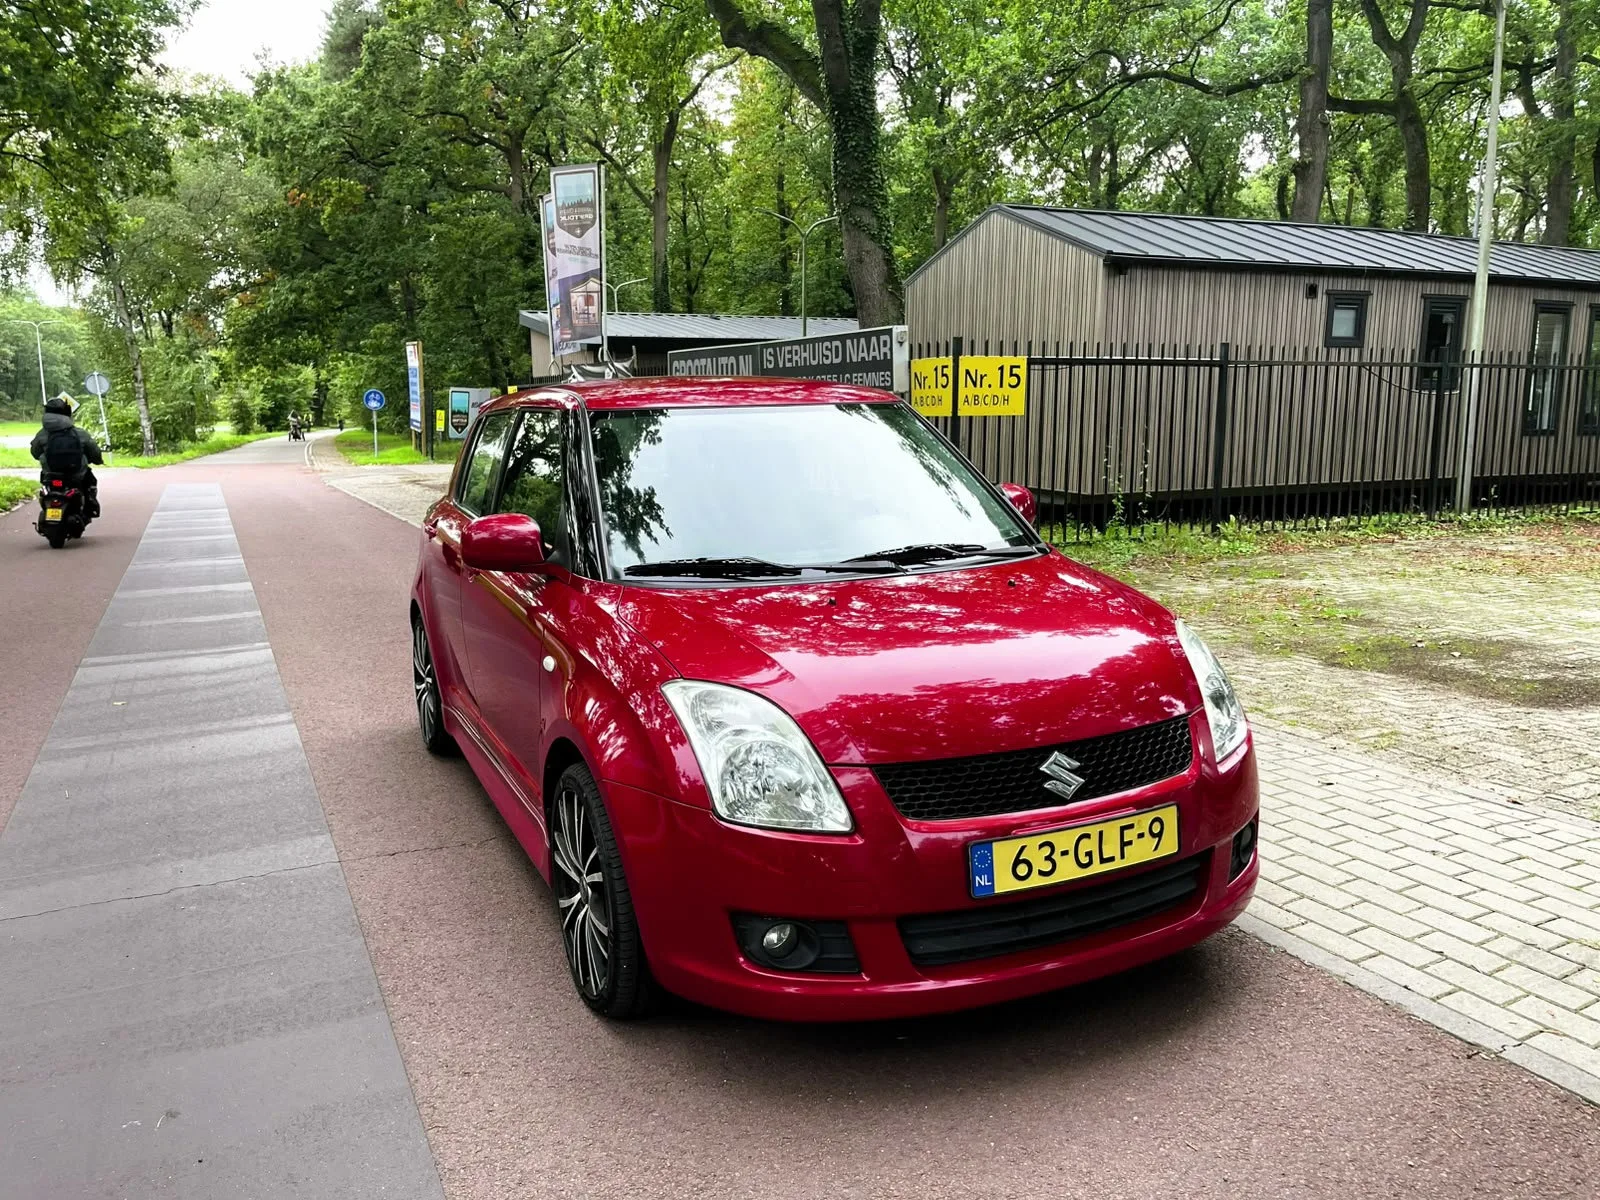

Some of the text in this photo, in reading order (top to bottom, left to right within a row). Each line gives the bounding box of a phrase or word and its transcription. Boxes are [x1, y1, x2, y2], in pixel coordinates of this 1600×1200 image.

[763, 347, 775, 369] IS
[776, 340, 842, 369] VERHUISD
[846, 334, 892, 363] NAAR
[934, 365, 949, 389] 15
[964, 364, 1021, 389] Nr. 15
[1011, 816, 1165, 882] 63-GLF-9
[975, 875, 992, 887] NL
